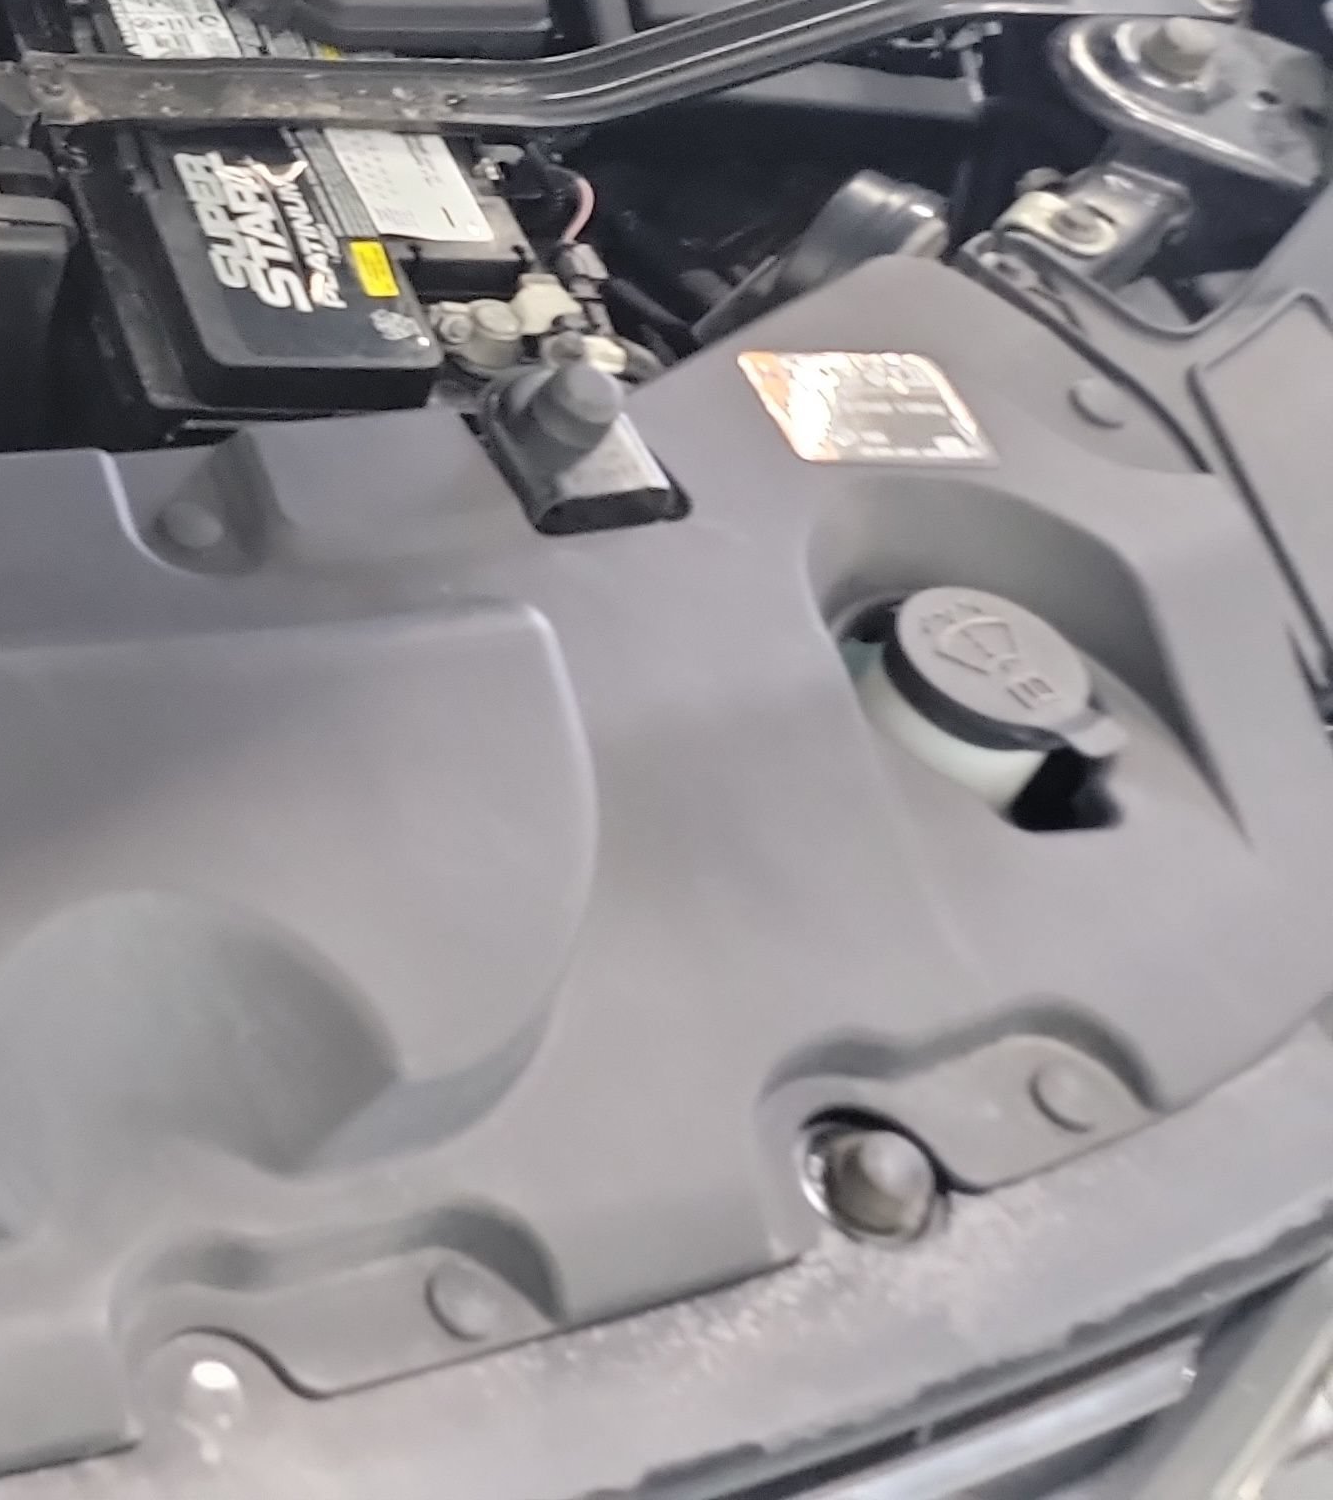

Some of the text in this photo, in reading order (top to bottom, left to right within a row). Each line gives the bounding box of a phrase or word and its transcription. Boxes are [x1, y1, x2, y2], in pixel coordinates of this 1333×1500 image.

[173, 152, 248, 288] SUPER
[205, 150, 314, 313] START
[276, 176, 347, 309] PLATINUM
